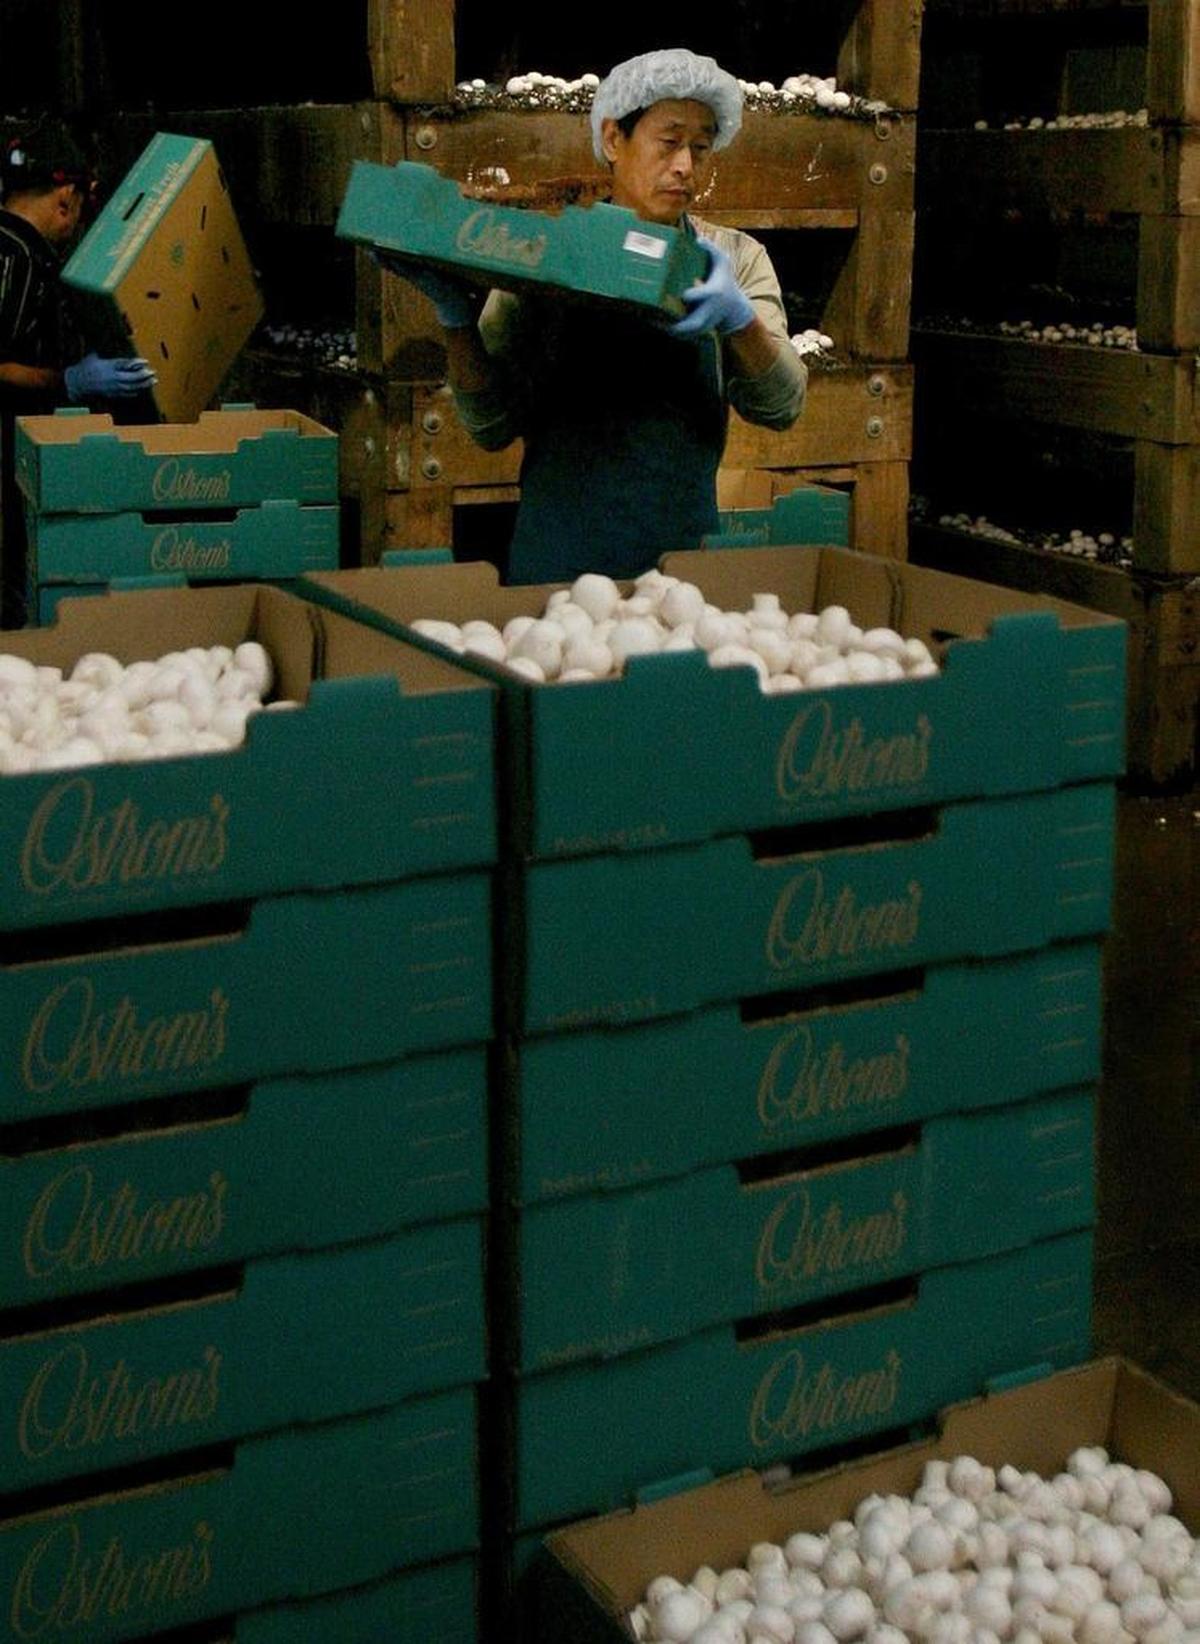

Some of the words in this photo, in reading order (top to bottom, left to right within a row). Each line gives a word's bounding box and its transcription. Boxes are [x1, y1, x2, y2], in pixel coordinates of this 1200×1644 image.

[151, 459, 232, 502] Ostrom's
[151, 528, 232, 572] Ostrom's
[774, 699, 934, 799] Ostrom's
[20, 777, 230, 895] Ostrom's
[766, 869, 923, 971] Ostrom's
[21, 975, 230, 1093] Ostrom's
[756, 1026, 910, 1128] Ostrom's
[22, 1164, 231, 1279] Ostrom's
[753, 1190, 909, 1290] Ostrom's
[17, 1343, 224, 1459] Ostrom's
[749, 1349, 901, 1448] Ostrom's
[10, 1521, 215, 1639] Ostrom's
